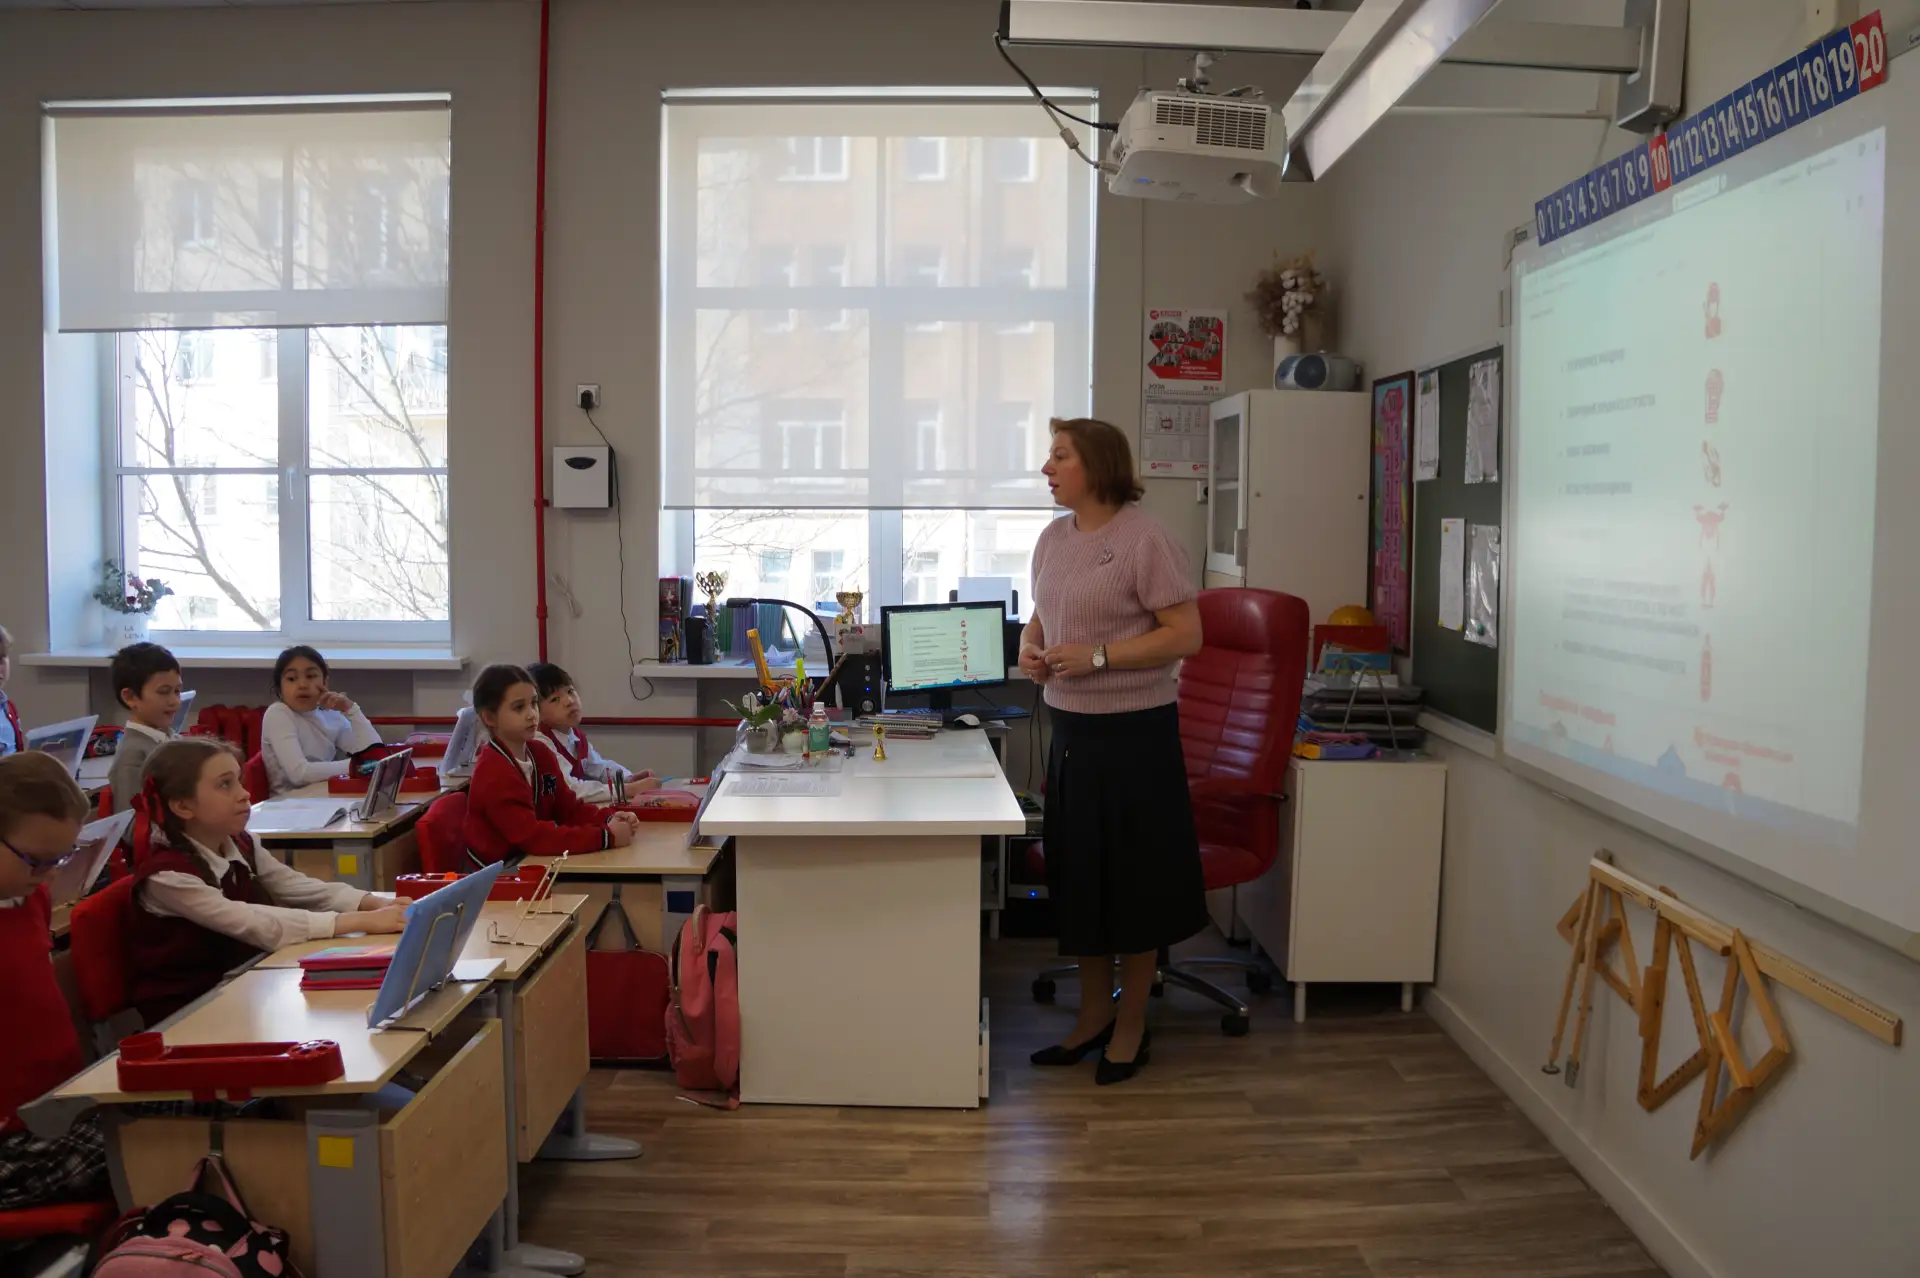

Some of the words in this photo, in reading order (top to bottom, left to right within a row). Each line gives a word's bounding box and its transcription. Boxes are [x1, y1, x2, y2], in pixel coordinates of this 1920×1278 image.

[1538, 209, 1545, 239] 0
[1547, 204, 1554, 234] 1
[1556, 199, 1565, 229] 2
[1567, 193, 1575, 224] 3
[1579, 187, 1587, 219] 4
[1588, 181, 1597, 214] 5
[1600, 174, 1610, 208] 6
[1610, 168, 1620, 203] 7
[1625, 161, 1636, 196] 8
[1639, 154, 1648, 190] 9
[1651, 145, 1668, 183] 10
[1669, 136, 1685, 176] 11
[1685, 126, 1703, 167] 12
[1701, 116, 1719, 158] 13
[1718, 105, 1740, 149] 14
[1737, 94, 1758, 138] 15
[1756, 81, 1781, 128] 16
[1778, 68, 1800, 117] 17
[1802, 56, 1829, 105] 18
[1827, 42, 1855, 93] 19
[1854, 26, 1884, 81] 20
